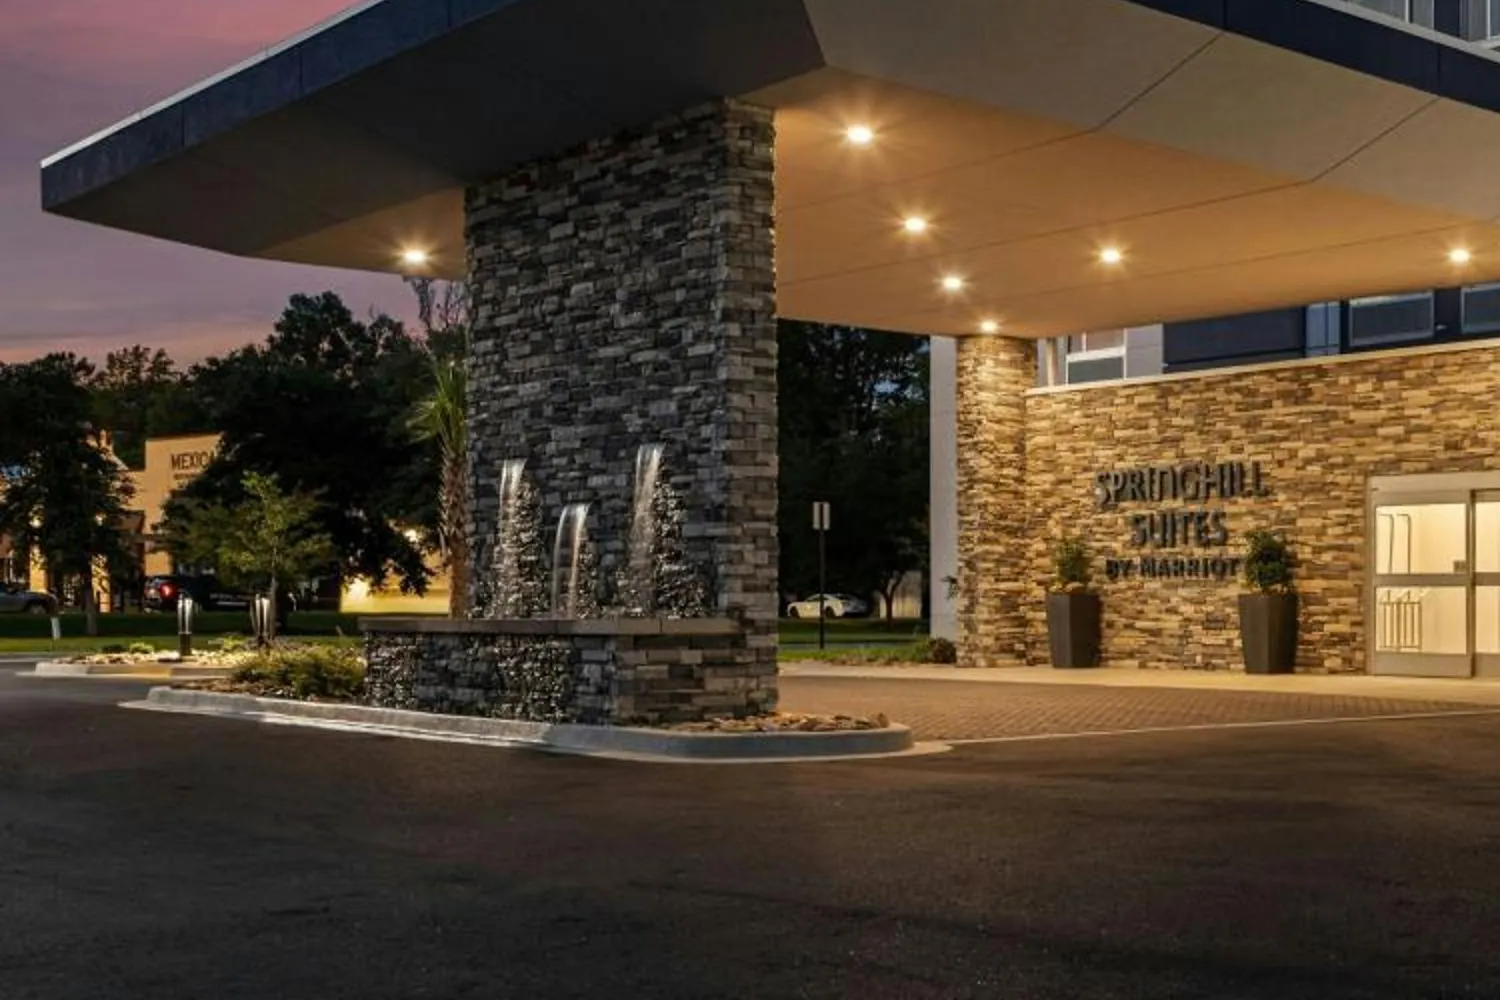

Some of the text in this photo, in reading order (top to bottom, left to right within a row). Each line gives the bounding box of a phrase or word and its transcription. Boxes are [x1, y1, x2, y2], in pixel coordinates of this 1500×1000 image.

[1096, 460, 1269, 504] SPRINGHILL
[1131, 509, 1228, 548] SUITES
[1106, 557, 1244, 580] BY MARRIOT
